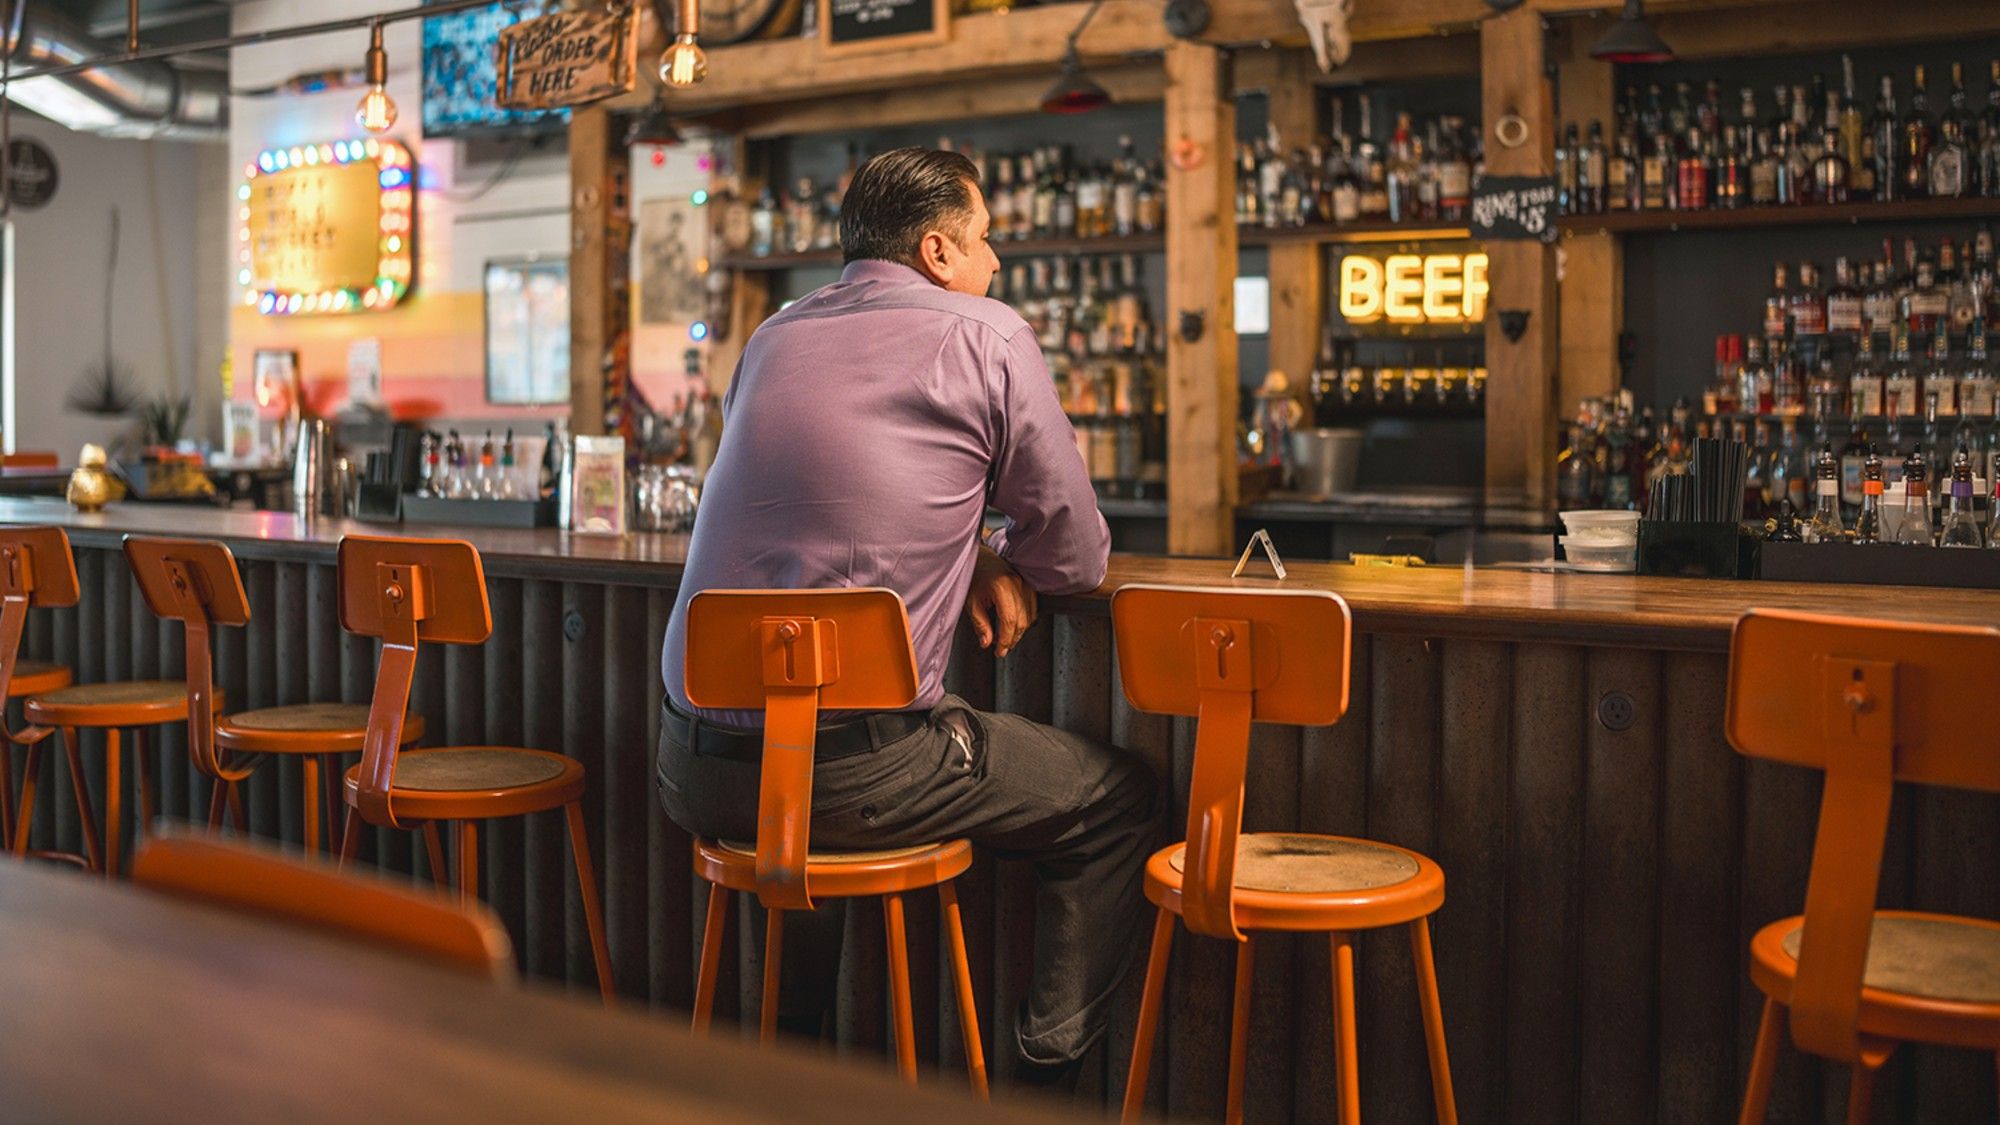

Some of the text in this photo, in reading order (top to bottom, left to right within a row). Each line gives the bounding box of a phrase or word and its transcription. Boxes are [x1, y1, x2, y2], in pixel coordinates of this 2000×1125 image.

[542, 36, 597, 66] ORDER
[530, 67, 577, 95] HERE
[1472, 190, 1517, 228] RING
